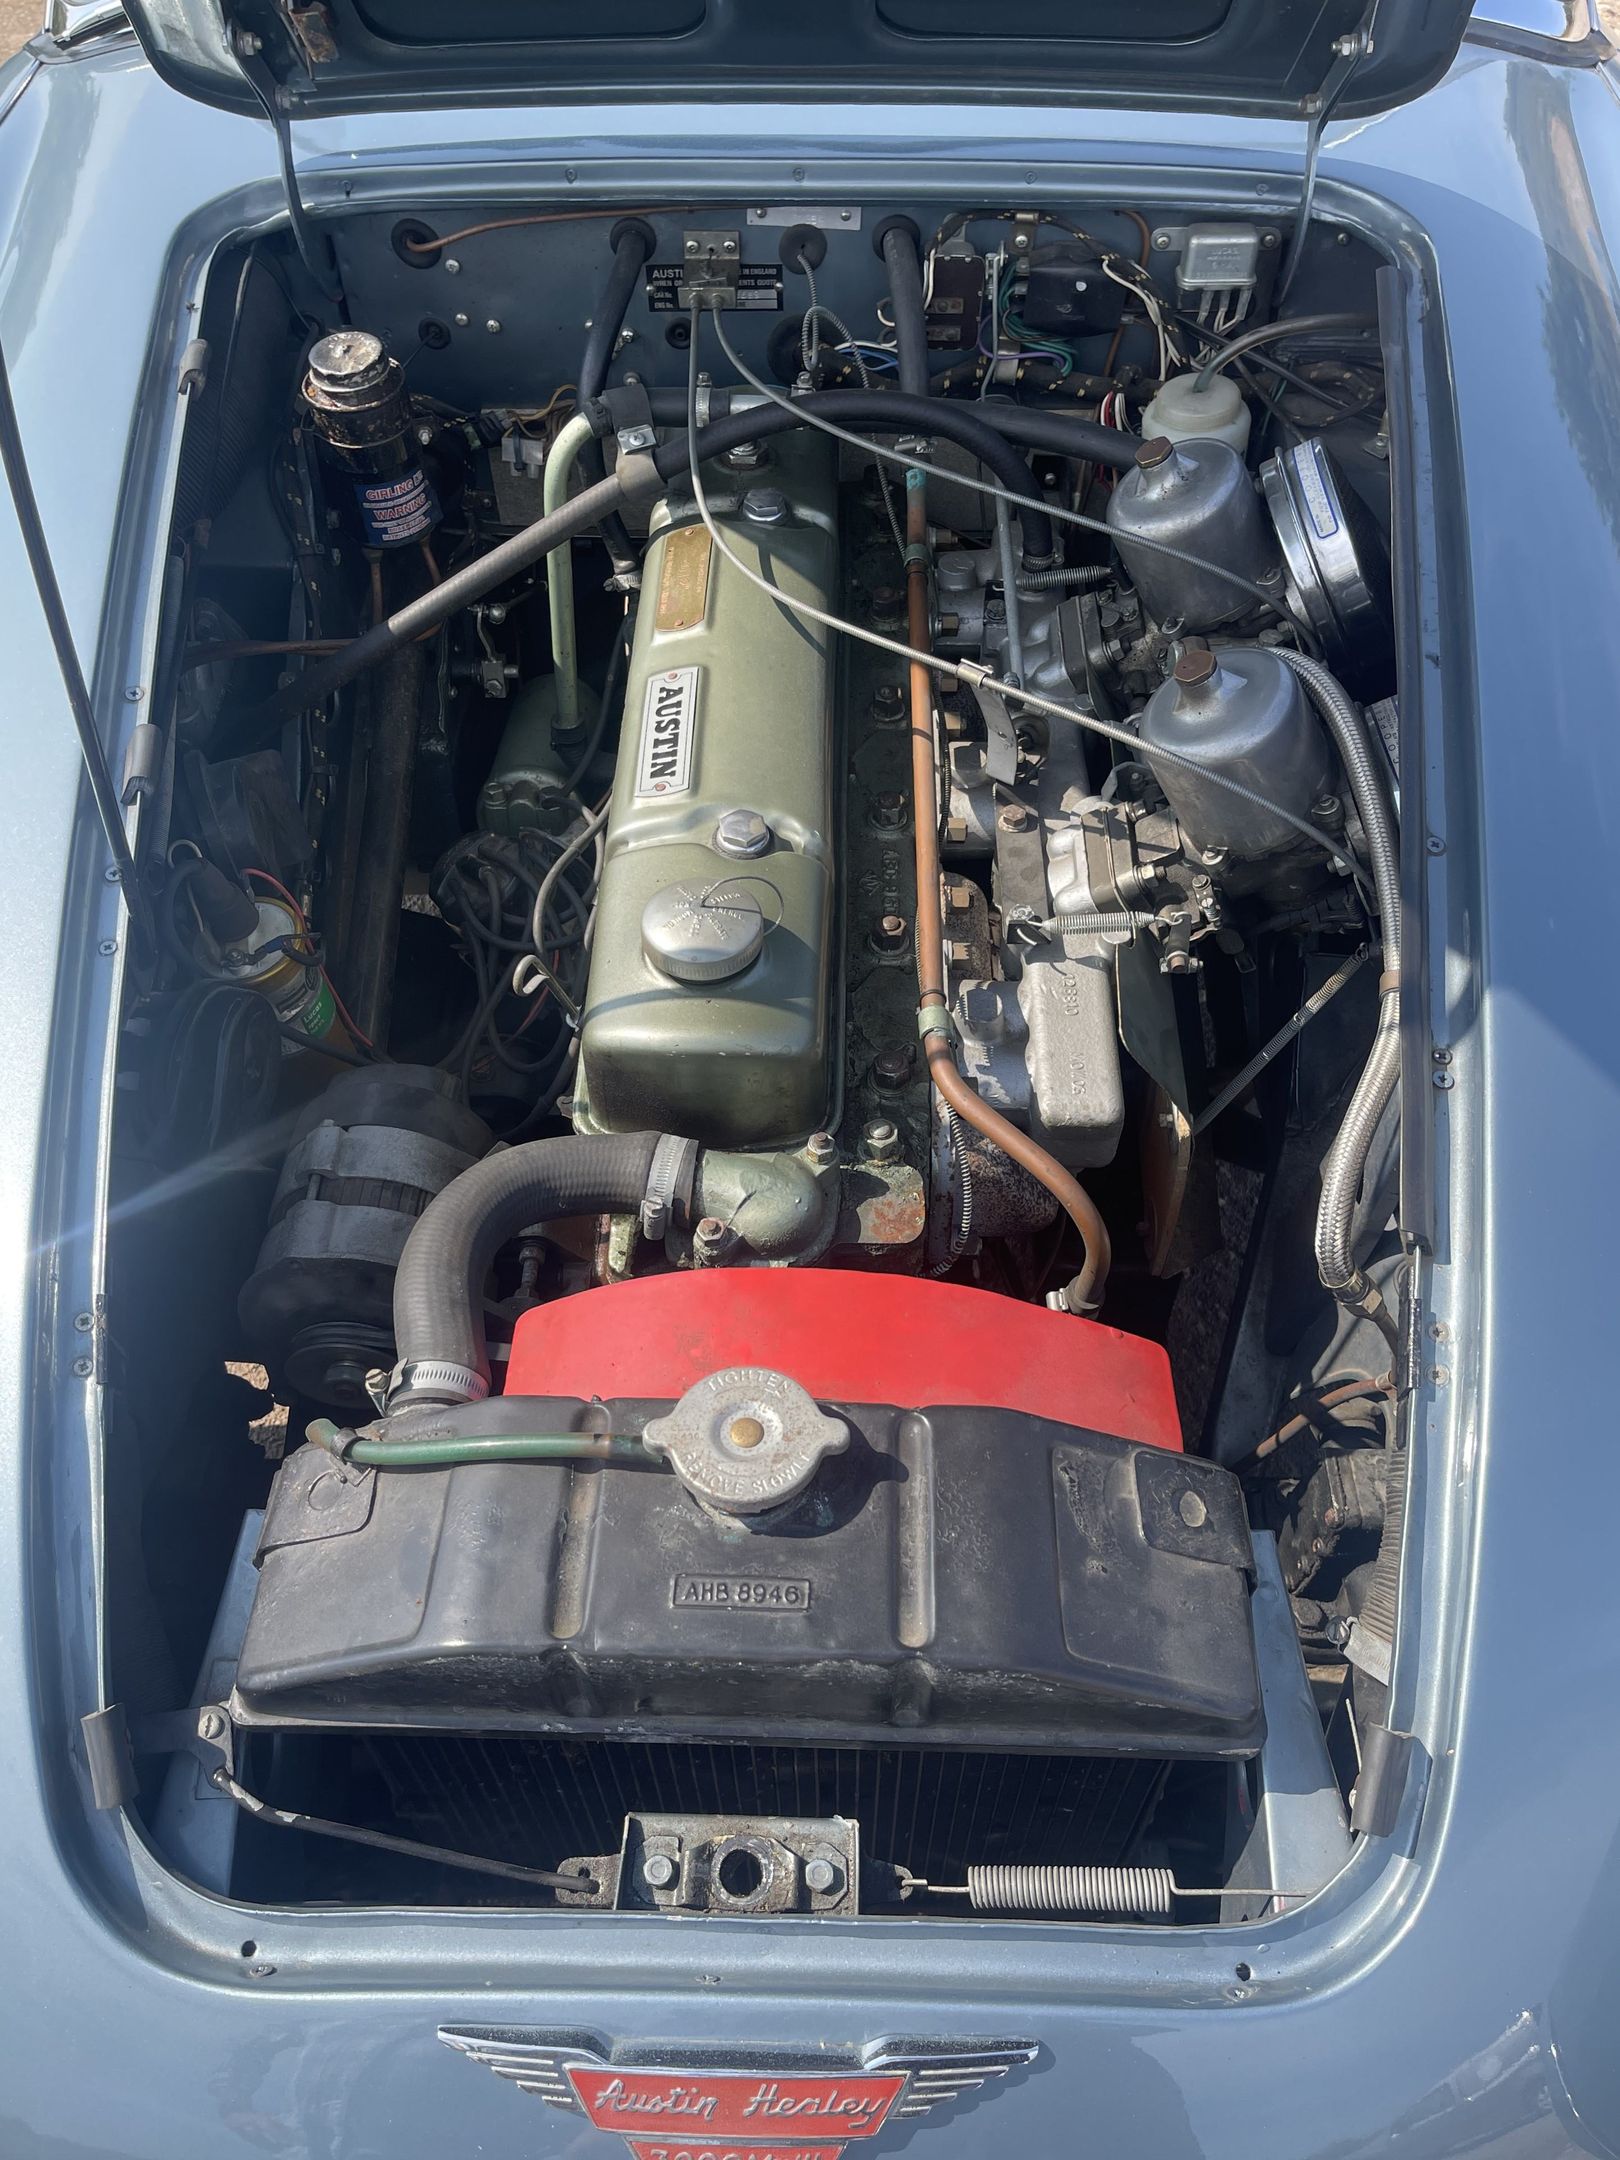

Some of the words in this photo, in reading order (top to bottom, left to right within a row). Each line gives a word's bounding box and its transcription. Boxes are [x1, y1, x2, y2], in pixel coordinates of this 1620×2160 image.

[652, 269, 683, 279] AUSTI
[365, 478, 414, 501] GIRLING
[373, 493, 427, 521] WARNING
[650, 686, 684, 779] AUSTIN
[708, 1369, 793, 1393] TIGHTEN
[684, 1451, 745, 1495] REMOVE
[752, 1450, 811, 1494] SLOWLY
[682, 1582, 729, 1601] AHB
[734, 1583, 800, 1605] 8946
[596, 2078, 720, 2121] Austin
[743, 2083, 888, 2129] Healey
